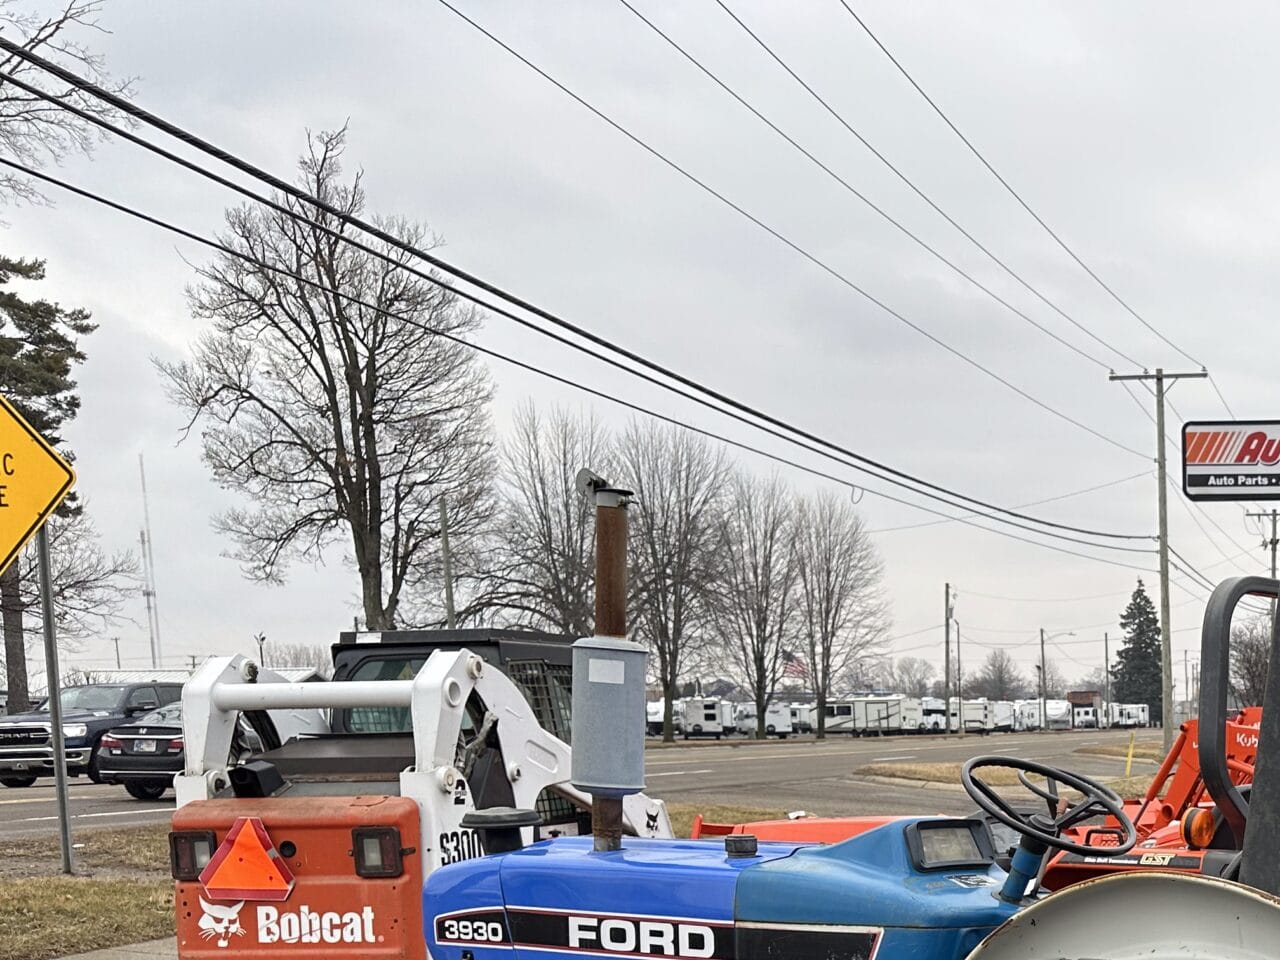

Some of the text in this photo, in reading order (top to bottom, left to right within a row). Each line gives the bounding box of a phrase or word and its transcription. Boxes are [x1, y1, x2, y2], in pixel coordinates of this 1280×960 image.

[1208, 476, 1234, 485] Auto
[1238, 476, 1268, 485] Parts
[1237, 733, 1259, 747] Kub
[1140, 853, 1176, 866] GST
[256, 904, 376, 944] Bobcat
[444, 920, 503, 942] 3930
[568, 916, 714, 959] FORD
